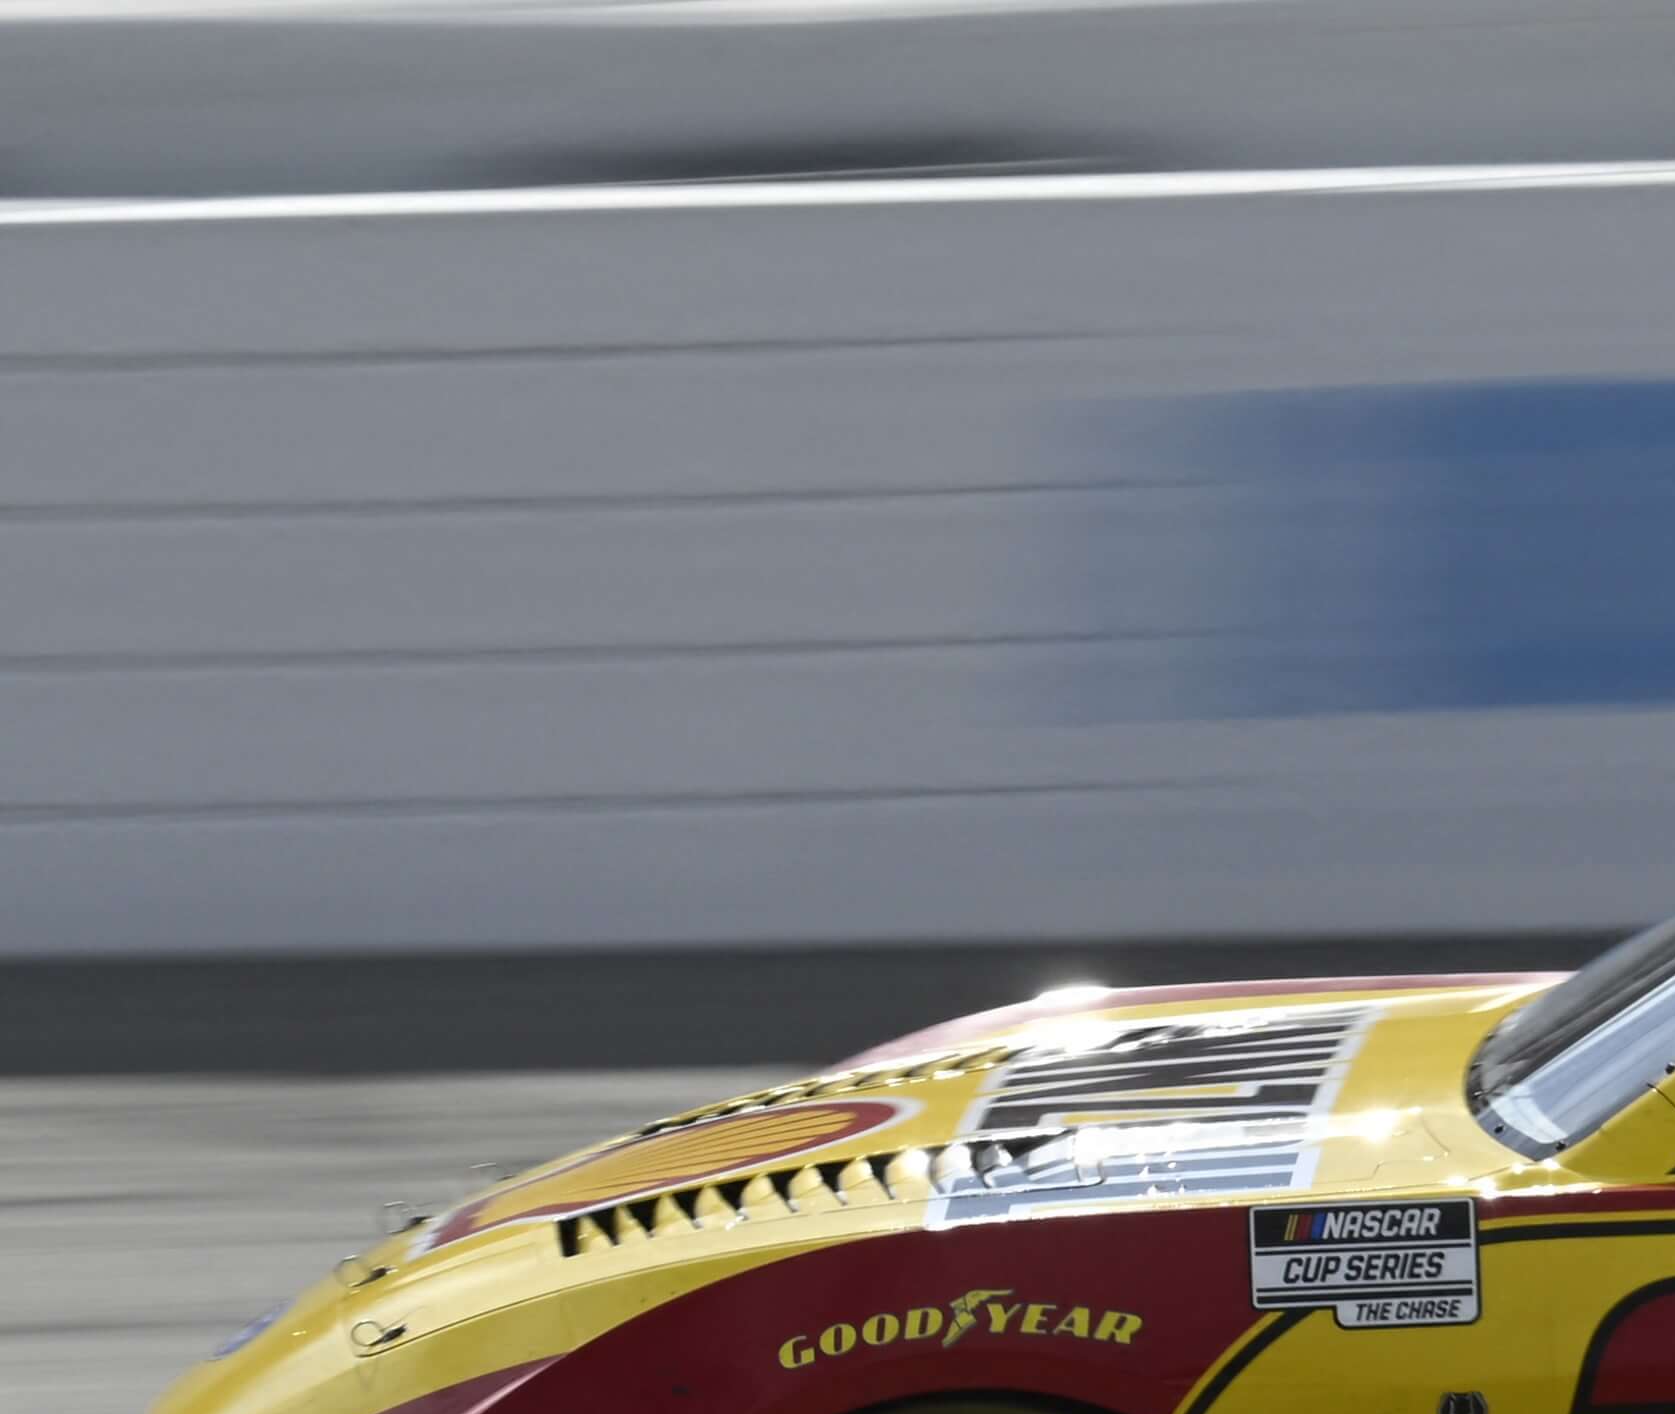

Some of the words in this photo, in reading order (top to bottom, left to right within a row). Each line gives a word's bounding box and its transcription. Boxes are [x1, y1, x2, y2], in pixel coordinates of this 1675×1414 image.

[1322, 1208, 1441, 1240] NASCAR
[1283, 1256, 1341, 1284] CUP
[1345, 1252, 1445, 1281] SERIES
[1356, 1303, 1392, 1321] THE
[1396, 1300, 1461, 1320] CHASE
